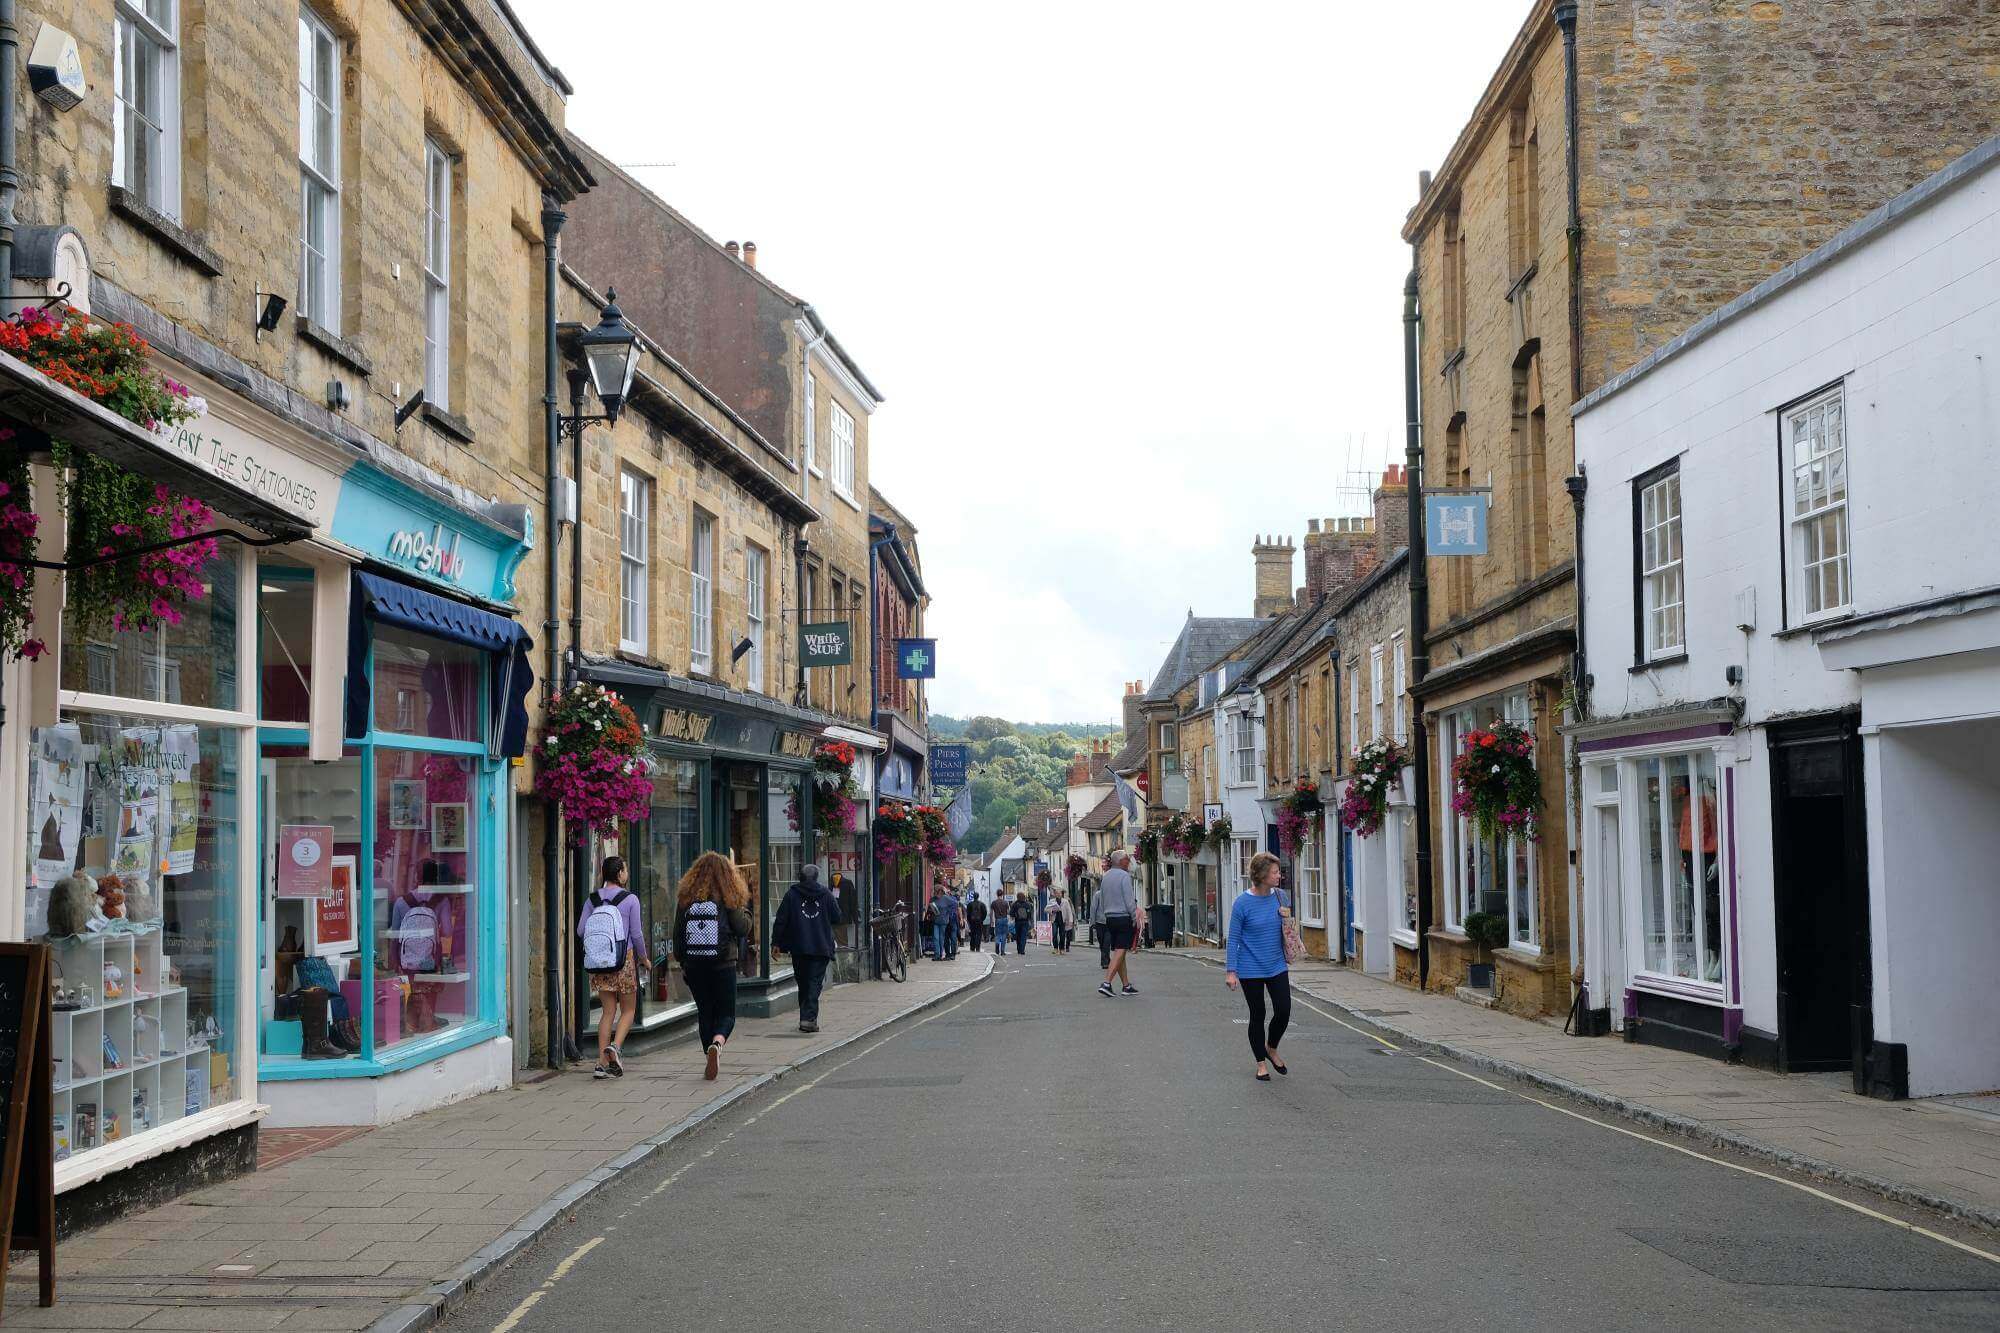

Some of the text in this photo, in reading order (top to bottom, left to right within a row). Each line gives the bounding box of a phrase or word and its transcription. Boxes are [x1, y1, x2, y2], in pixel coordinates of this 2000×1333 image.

[209, 438, 237, 475] THE
[242, 456, 317, 510] STATIONERS
[389, 523, 464, 580] moshulu
[937, 749, 960, 758] PIERS
[934, 759, 962, 769] PISANI
[303, 846, 309, 857] 3
